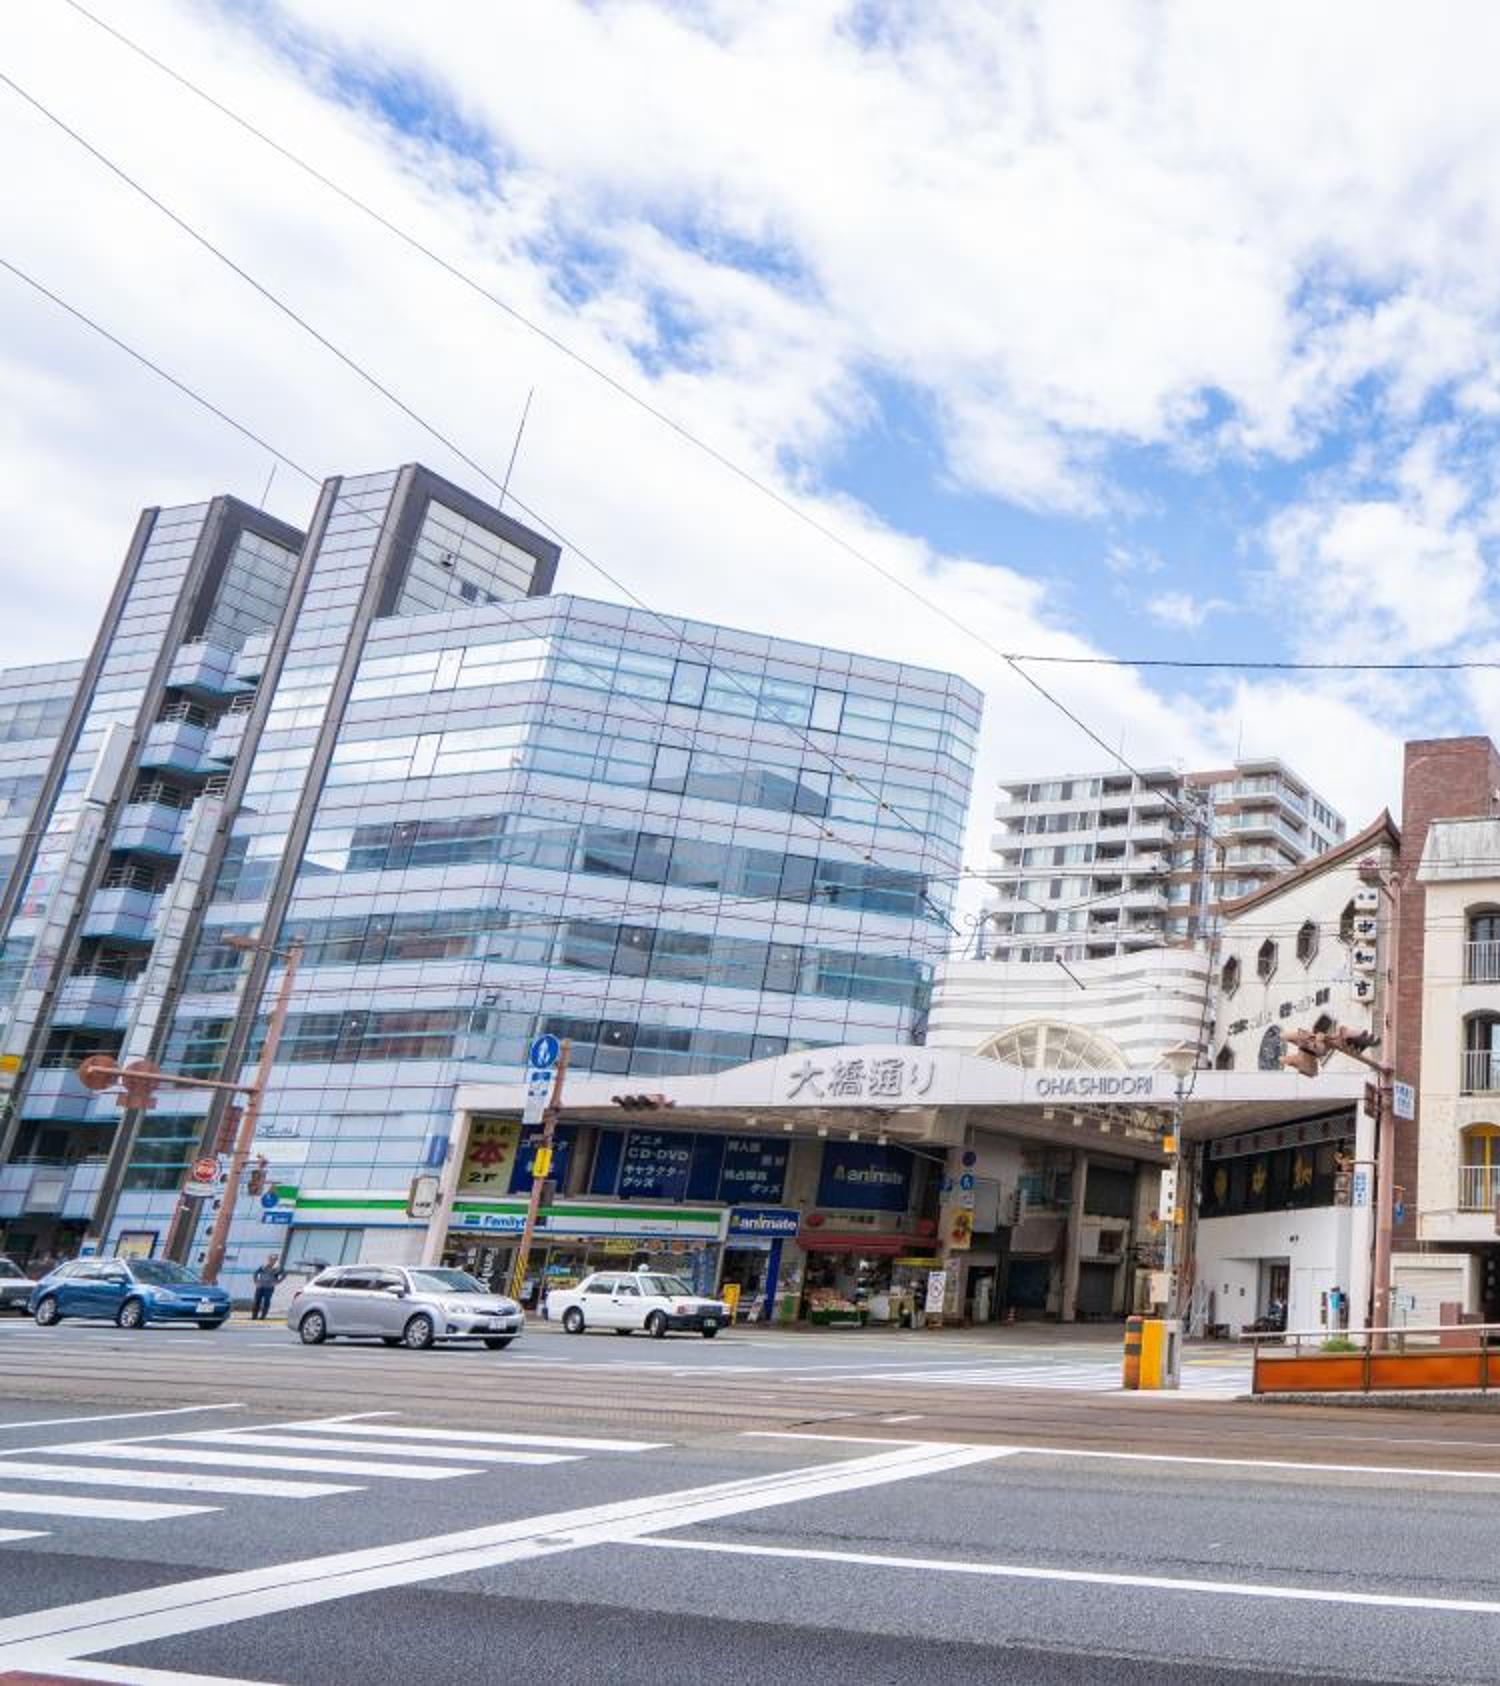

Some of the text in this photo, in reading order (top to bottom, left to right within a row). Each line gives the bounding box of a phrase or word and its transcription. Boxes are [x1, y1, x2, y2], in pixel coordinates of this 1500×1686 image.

[786, 1056, 937, 1098] 大橋通り
[1035, 1075, 1154, 1097] OHASHIDORI
[739, 1213, 798, 1231] animate
